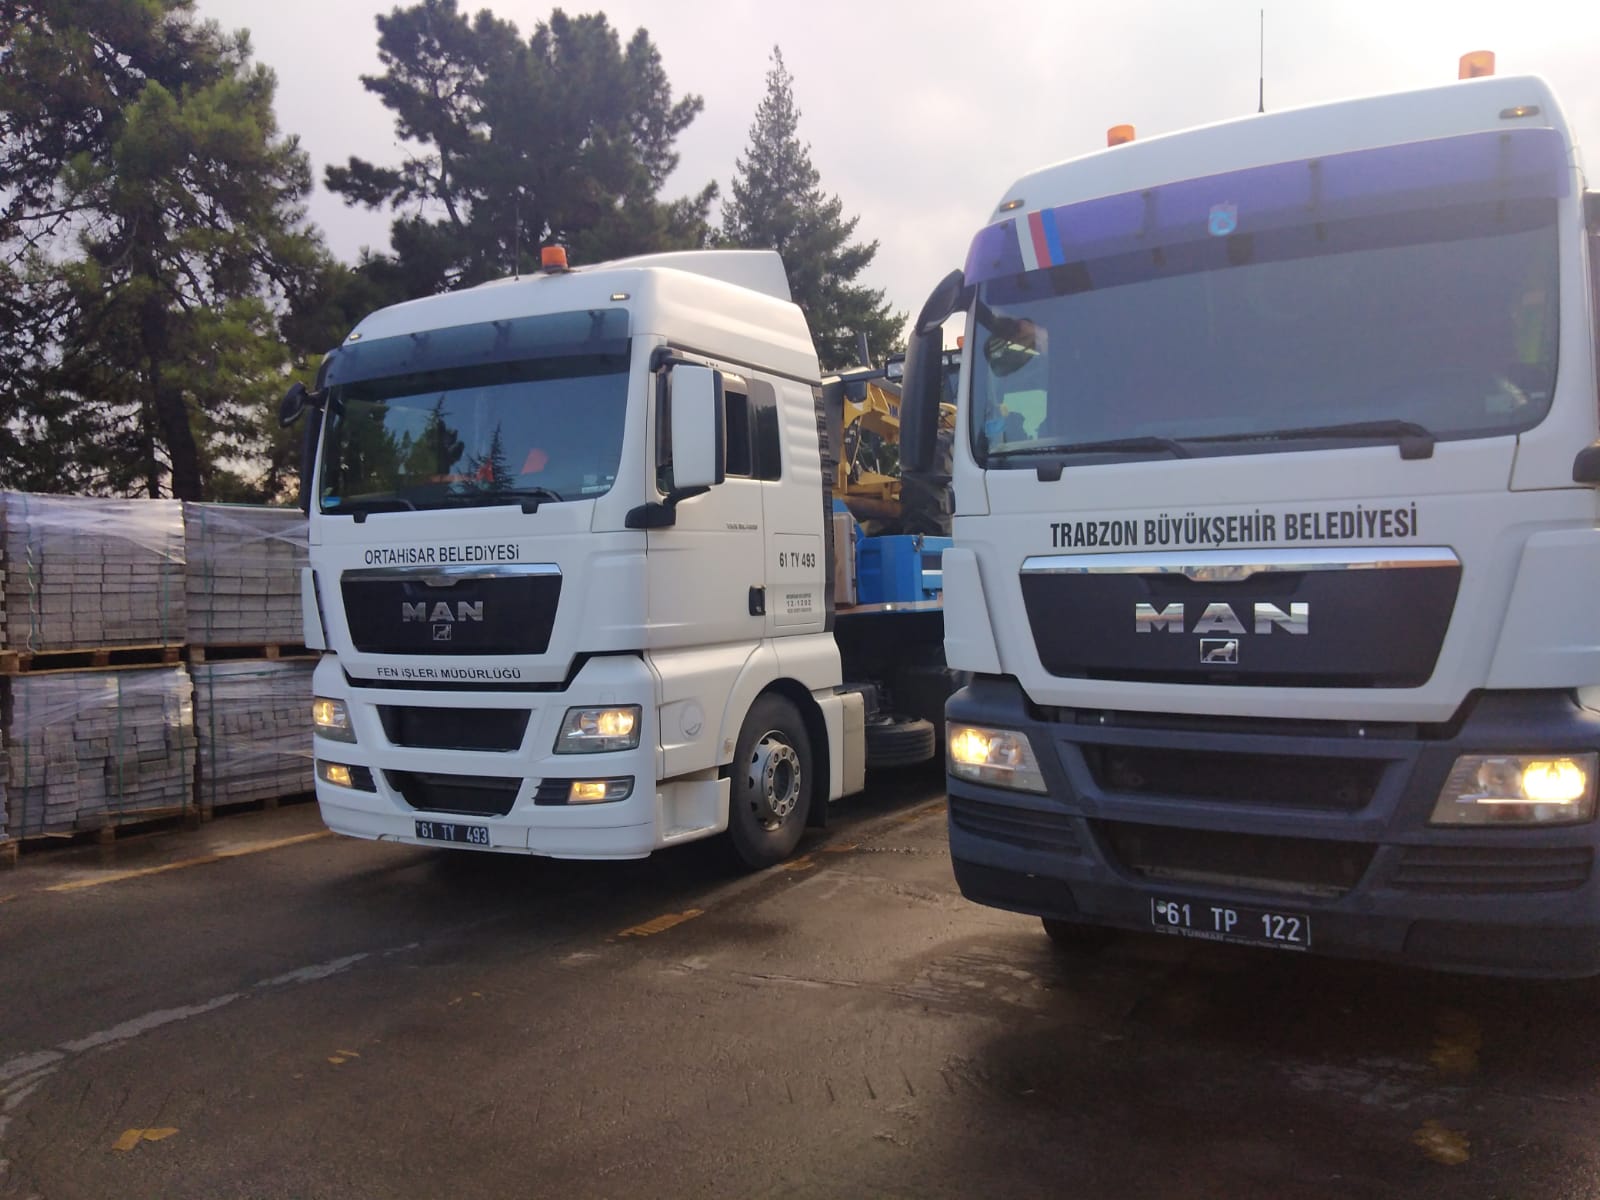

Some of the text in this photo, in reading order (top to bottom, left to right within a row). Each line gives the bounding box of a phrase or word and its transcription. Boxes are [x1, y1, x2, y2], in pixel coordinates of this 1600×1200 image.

[1050, 501, 1418, 548] TRABZON BÜYÜKŞEHİR BELEDİYESİ
[779, 552, 816, 568] 61 TY 493
[402, 601, 484, 622] MAN
[1135, 602, 1309, 634] MAN
[377, 667, 399, 678] FEN
[421, 822, 487, 844] 61 TY 493
[1166, 902, 1301, 942] 61 TP 122
